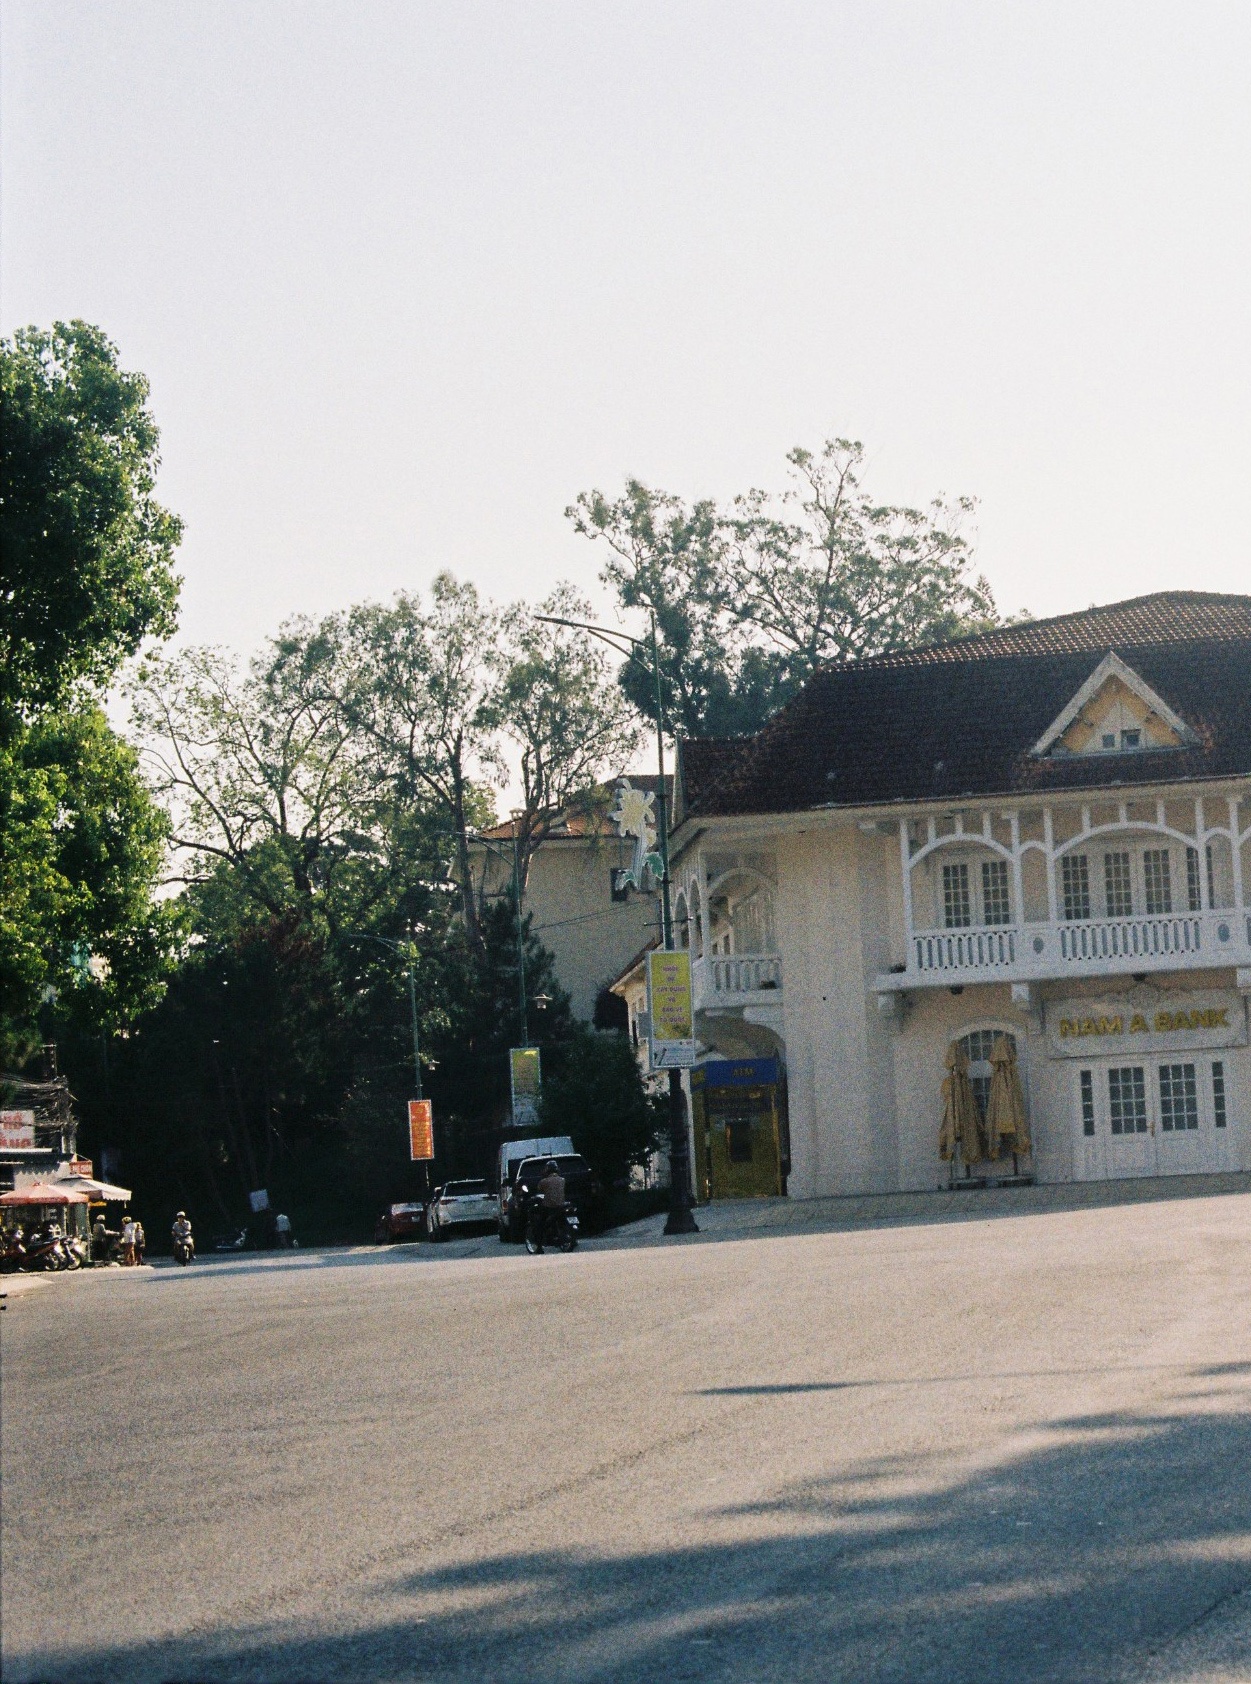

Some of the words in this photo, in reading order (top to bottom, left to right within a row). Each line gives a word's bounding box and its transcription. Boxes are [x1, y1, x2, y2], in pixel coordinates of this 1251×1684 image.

[1060, 1014, 1122, 1038] NAM
[1130, 1013, 1149, 1035] A
[1154, 1007, 1230, 1033] BANK
